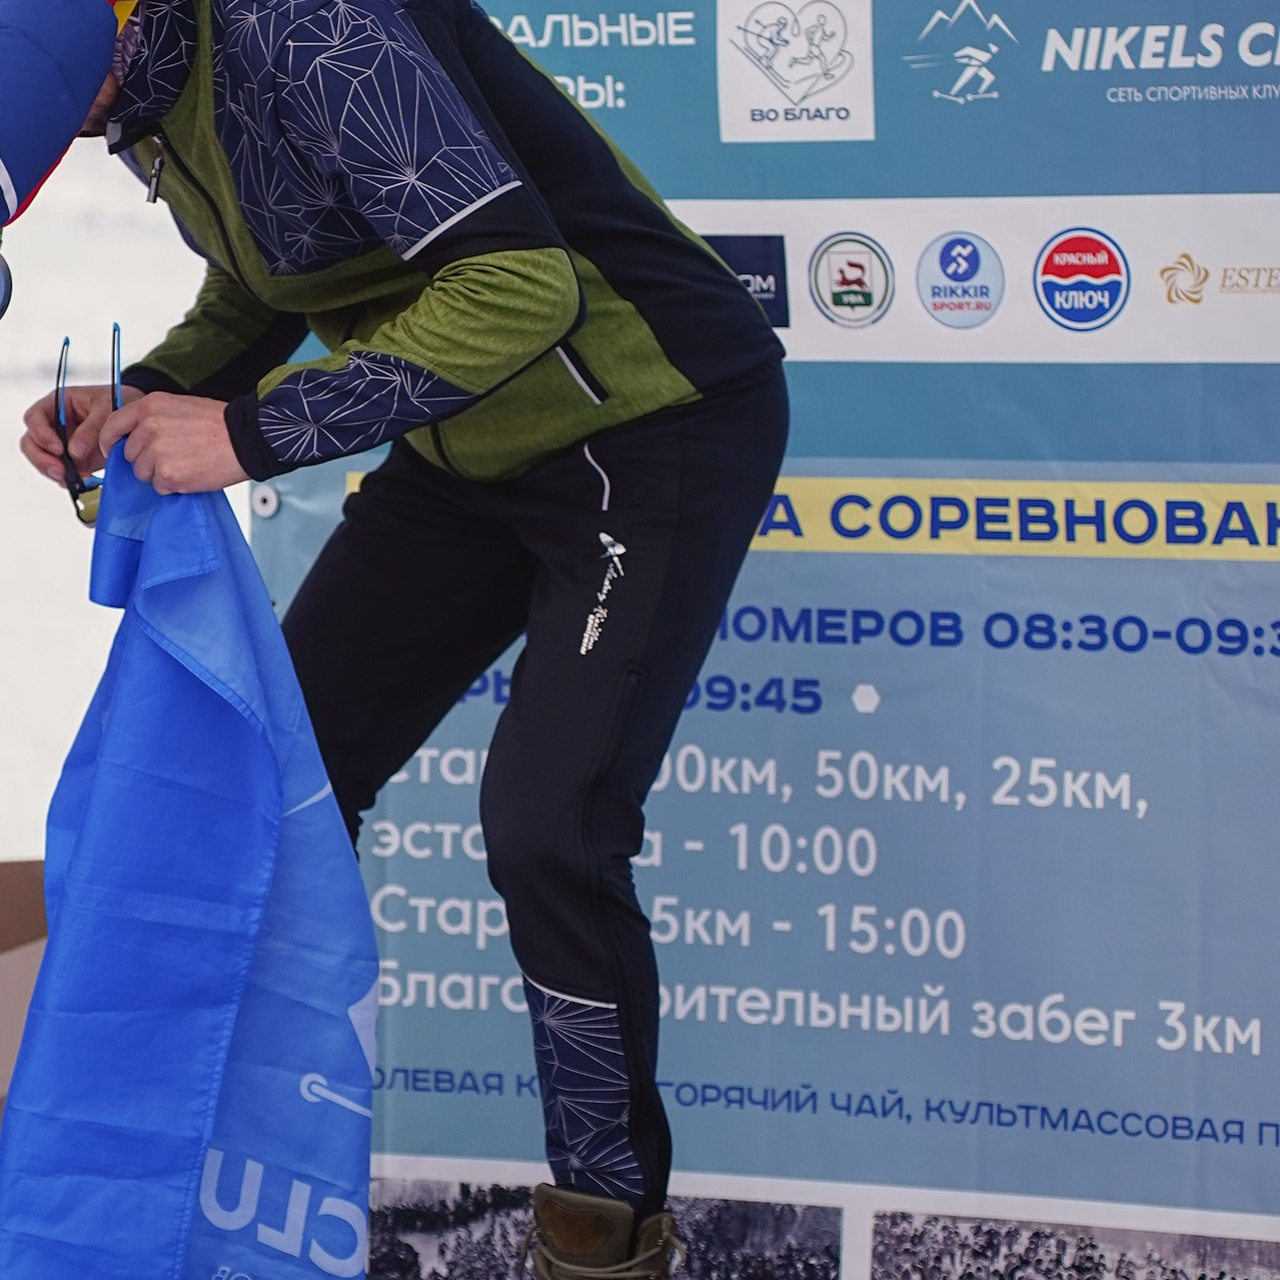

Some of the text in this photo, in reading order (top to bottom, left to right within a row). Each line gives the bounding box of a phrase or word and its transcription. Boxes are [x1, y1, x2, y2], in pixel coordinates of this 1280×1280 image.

[492, 12, 696, 47] АЛЬНЫЕ
[1041, 21, 1280, 72] NIKELS C
[750, 107, 850, 122] ВО БЛАГО
[1106, 86, 1143, 103] СЕТЬ
[1146, 84, 1248, 103] СПОРТИВНЫХ
[1053, 250, 1109, 265] КРАСНЫЙ
[931, 285, 990, 299] RIKKIR
[1054, 290, 1109, 309] КЛЮЧ
[815, 748, 966, 812] 50км,
[990, 756, 1148, 820] 25км,
[728, 821, 878, 878] 10:00
[372, 885, 510, 950] Стар
[817, 902, 967, 959] 15:00
[970, 993, 1136, 1047] забег
[1155, 999, 1263, 1057] 3км
[830, 1090, 913, 1124] ЧАЙ,
[924, 1098, 1245, 1146] КУЛЬТМАССОВАЯ
